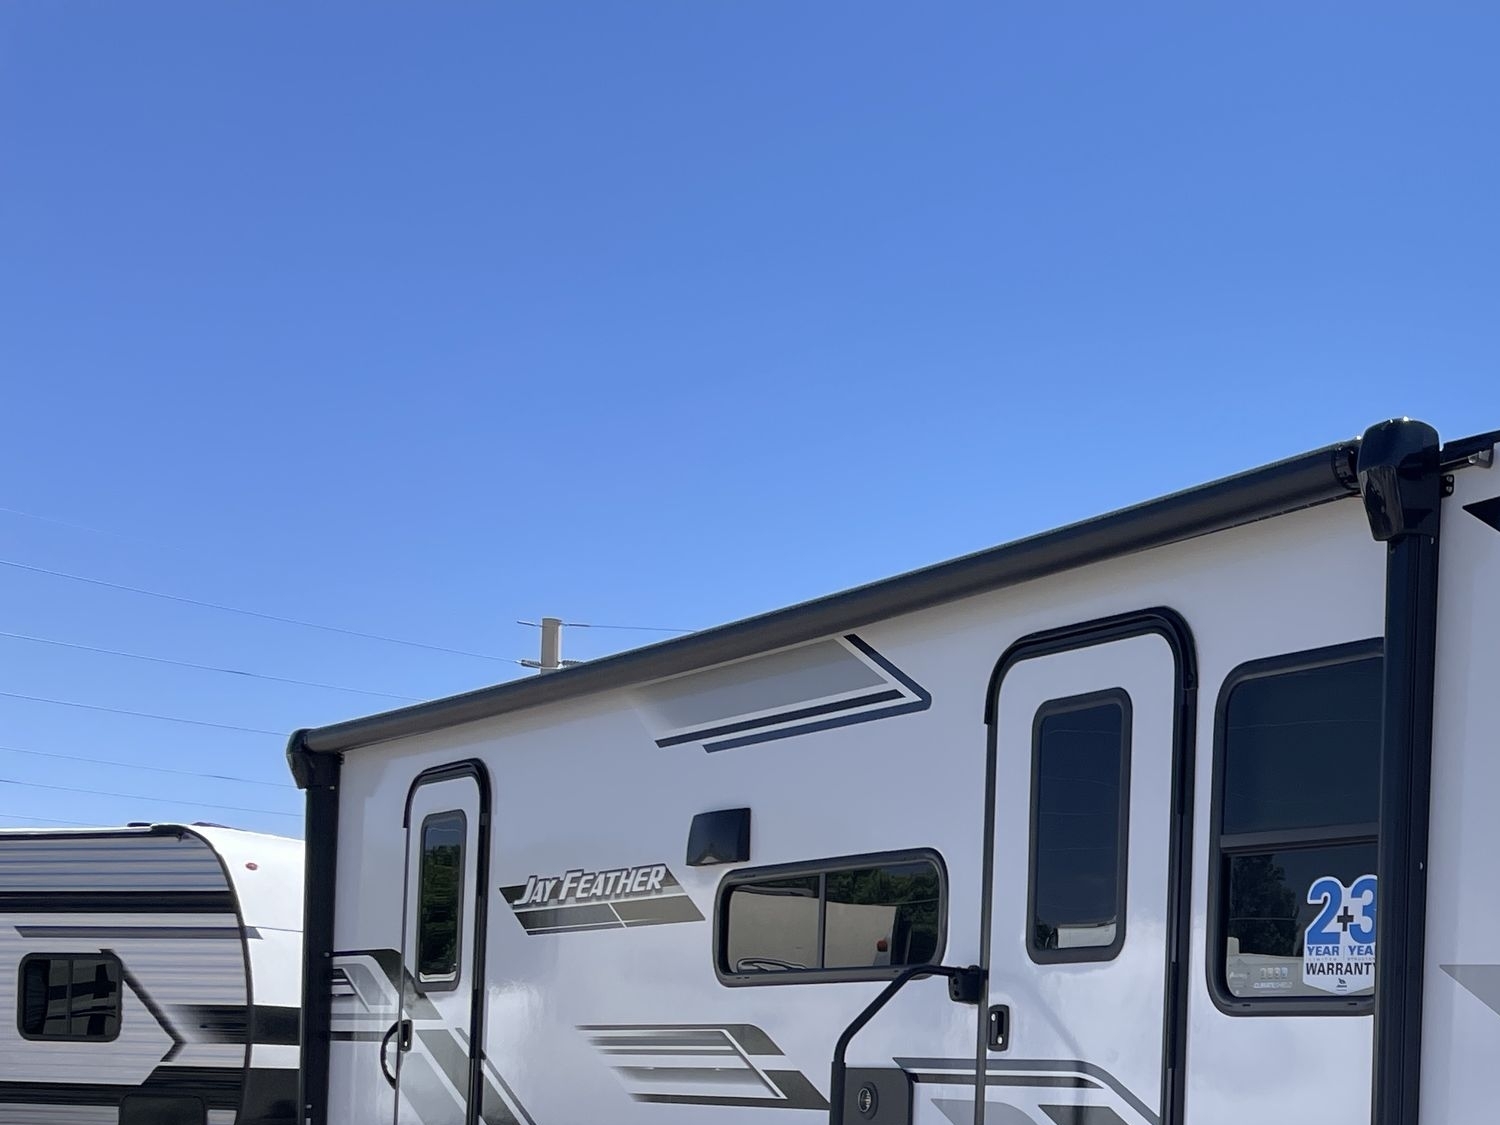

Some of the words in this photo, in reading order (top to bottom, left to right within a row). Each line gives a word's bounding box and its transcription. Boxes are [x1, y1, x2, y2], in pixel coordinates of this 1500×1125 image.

[513, 874, 558, 906] JAY
[558, 864, 667, 901] FEATHER
[1307, 946, 1340, 956] YEAR
[1348, 945, 1376, 956] YEA
